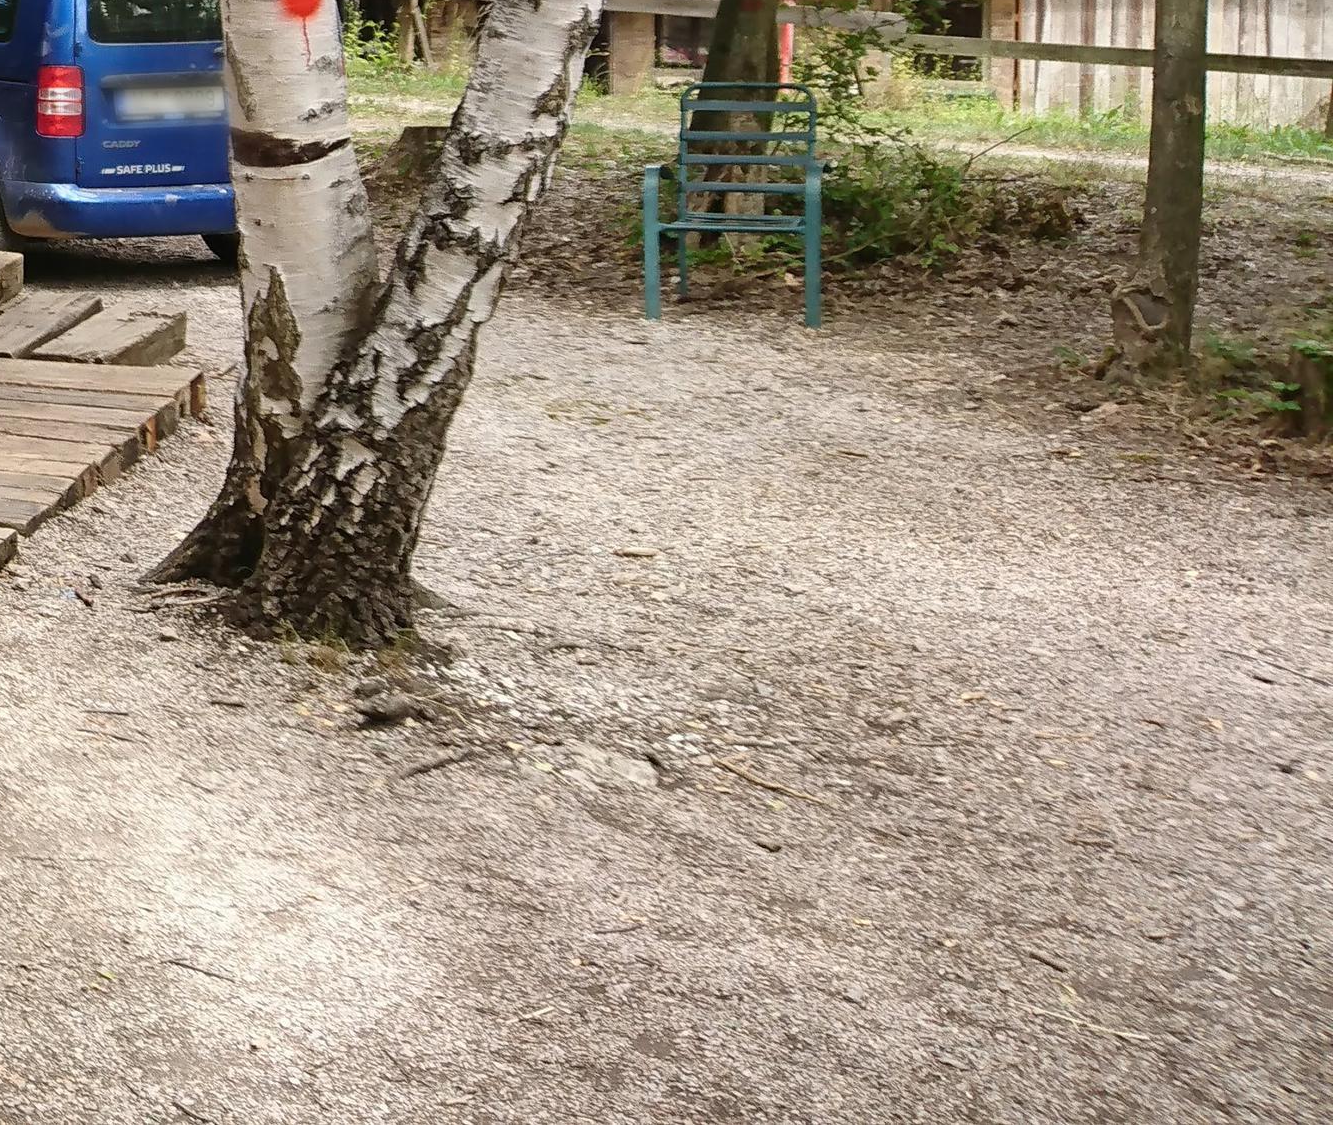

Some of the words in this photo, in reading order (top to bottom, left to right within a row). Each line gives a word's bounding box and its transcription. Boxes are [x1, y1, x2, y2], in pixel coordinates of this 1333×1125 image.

[102, 140, 141, 148] CADDY
[116, 165, 143, 175] SAFE
[144, 163, 171, 173] PLUS
